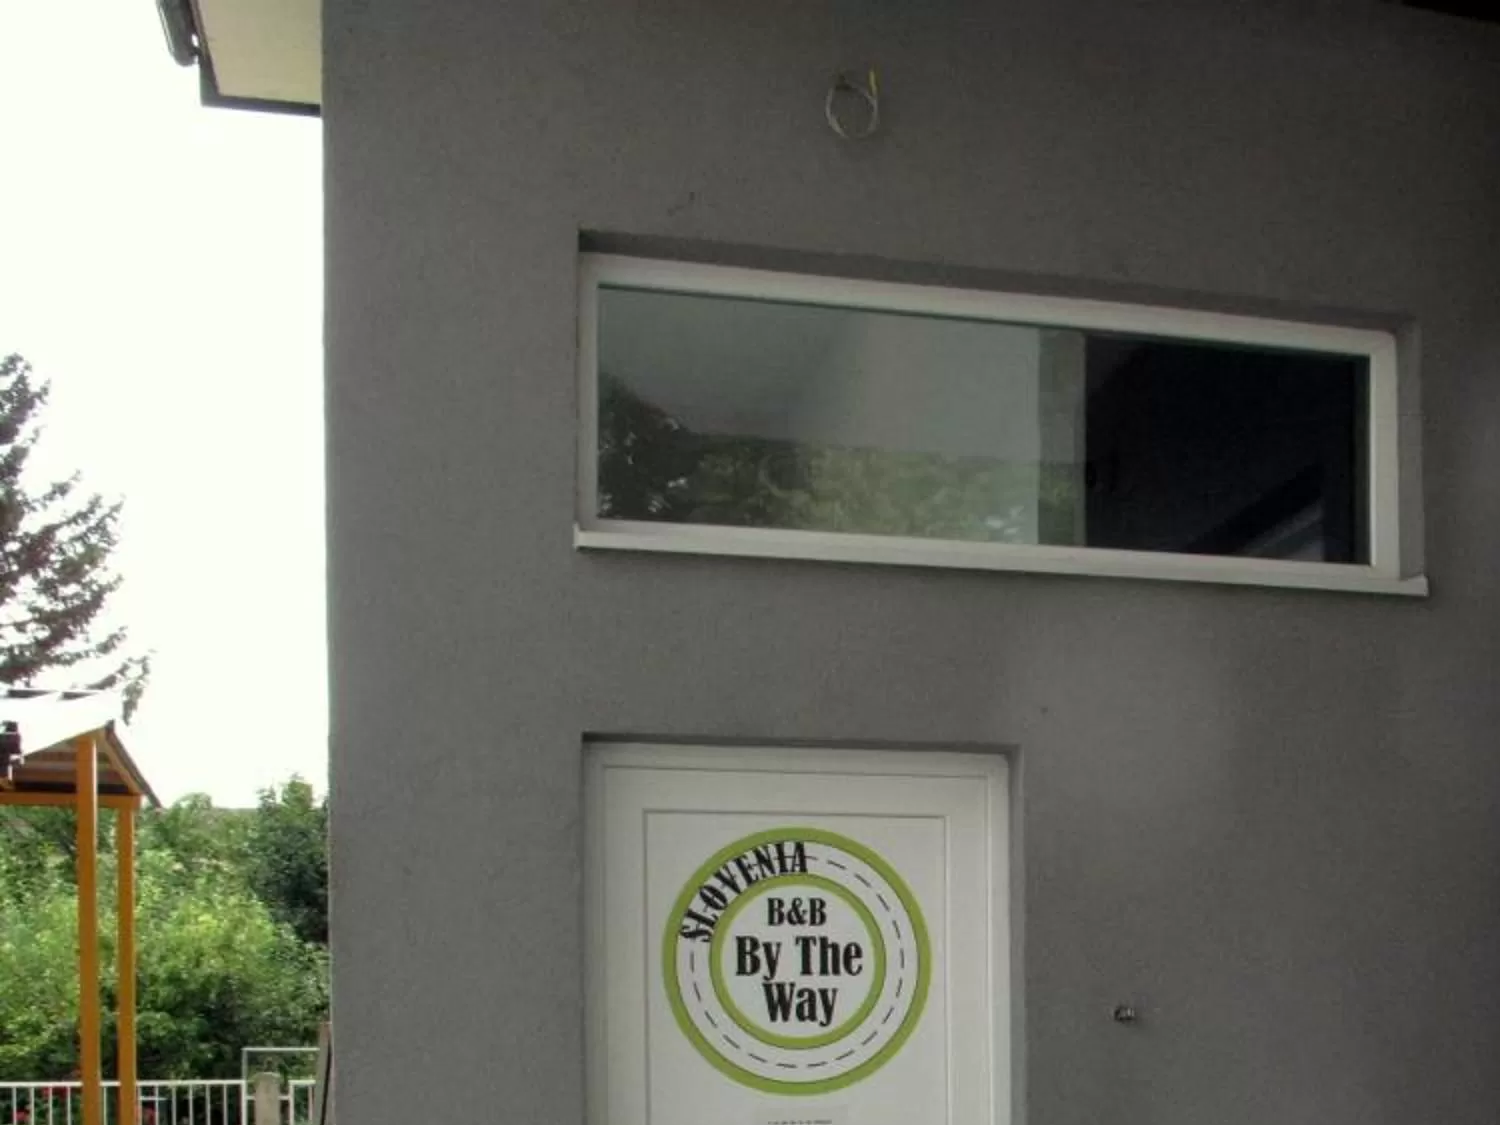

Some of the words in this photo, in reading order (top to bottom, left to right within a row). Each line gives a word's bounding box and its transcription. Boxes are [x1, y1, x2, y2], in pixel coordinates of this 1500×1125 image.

[680, 841, 808, 943] SLOVENIA
[767, 897, 827, 926] B&B
[735, 935, 782, 981] By
[795, 935, 863, 976] The
[762, 981, 839, 1027] Way
